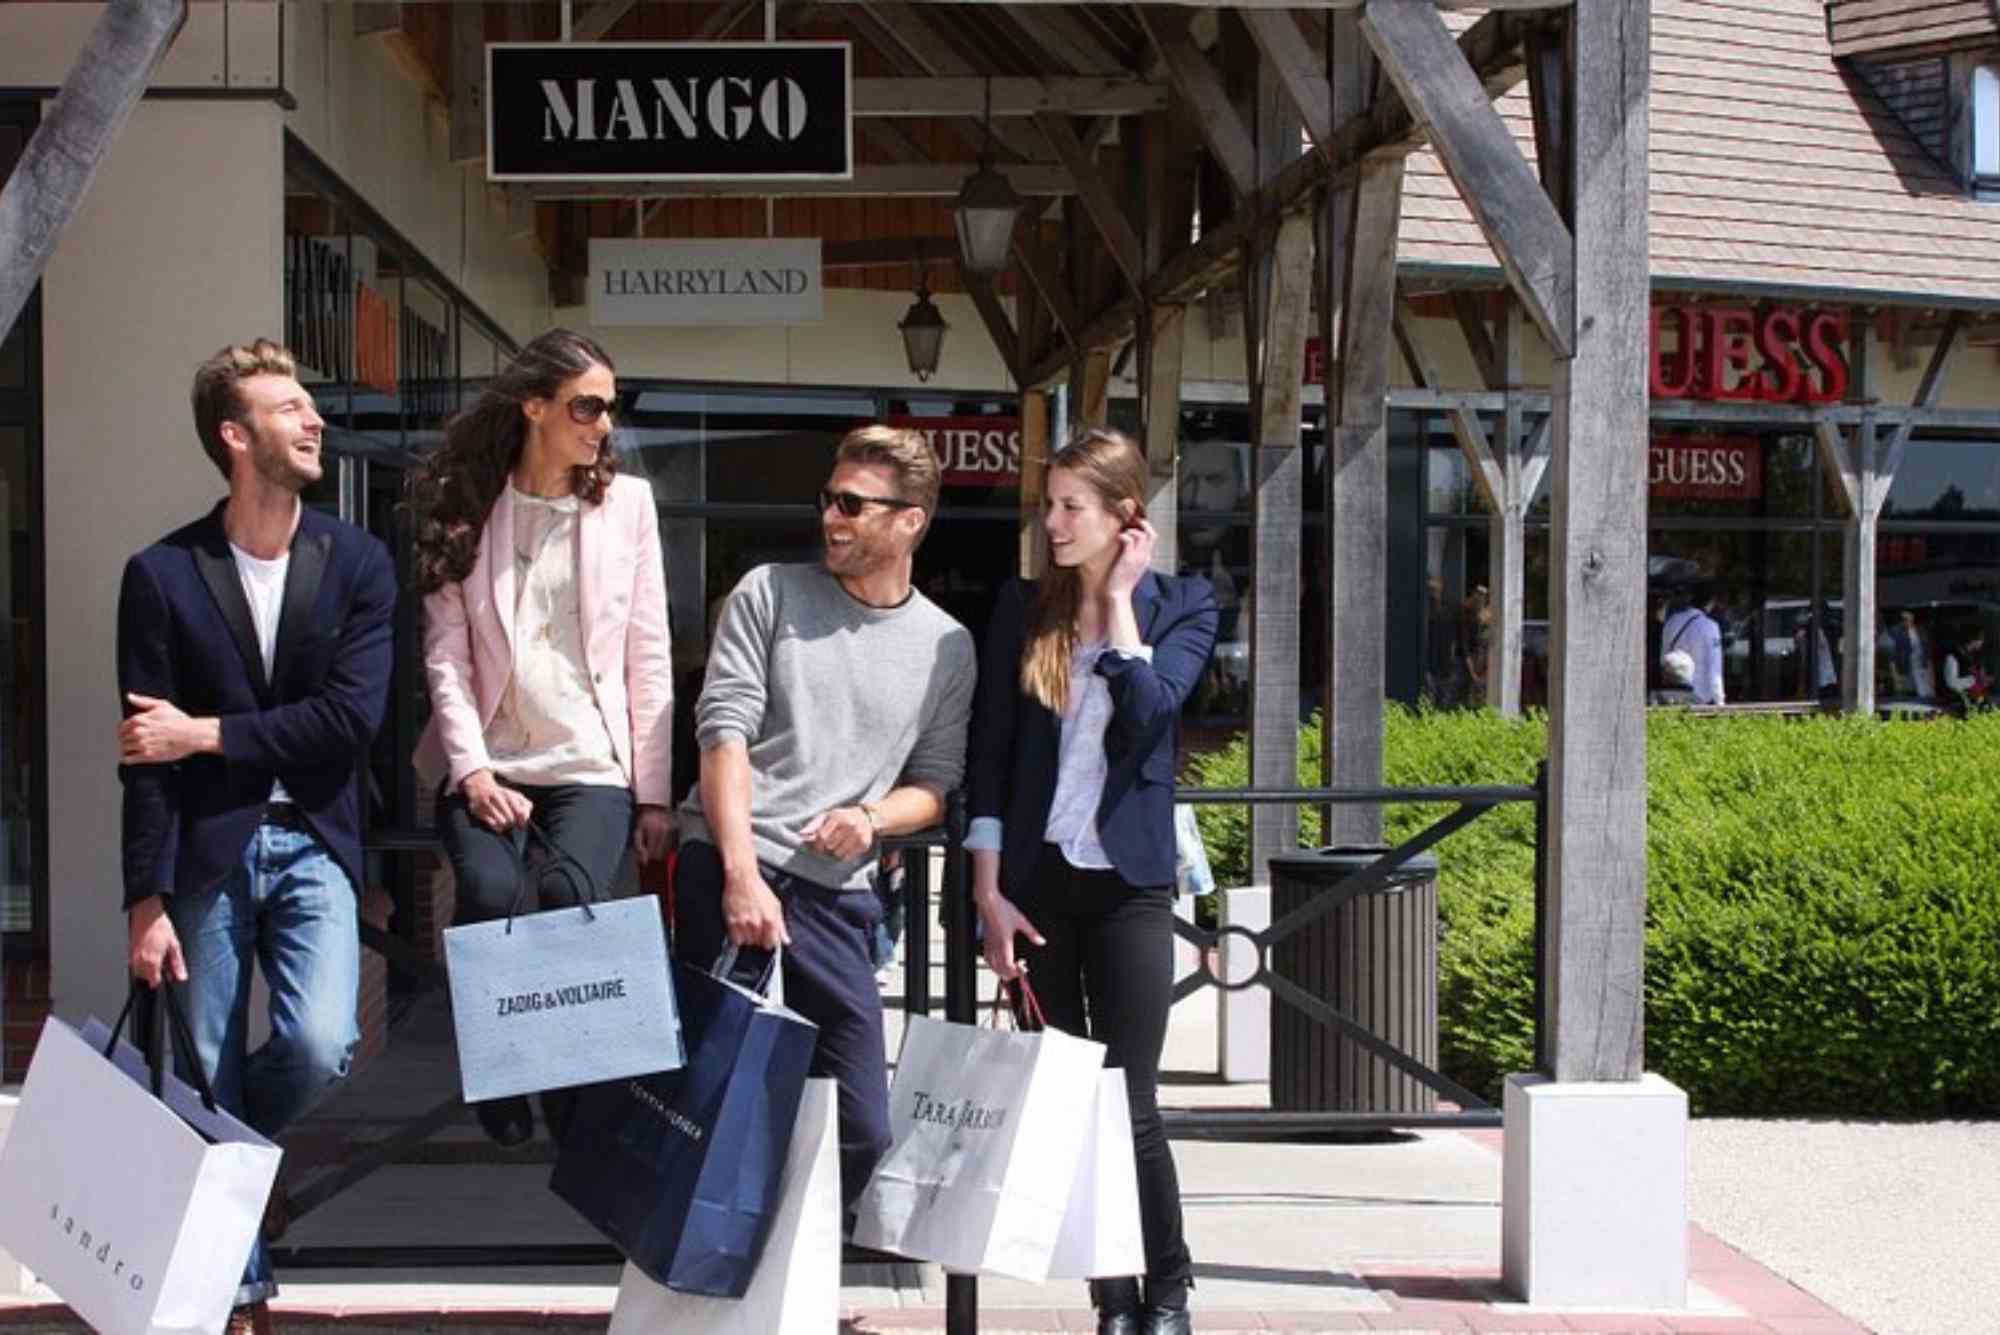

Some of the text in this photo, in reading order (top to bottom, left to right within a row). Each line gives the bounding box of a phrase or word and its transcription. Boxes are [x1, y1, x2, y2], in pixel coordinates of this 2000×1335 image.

[540, 77, 809, 141] MANGO
[604, 268, 810, 295] HARRYLAND
[1649, 303, 1851, 406] UESS
[925, 429, 1020, 473] UESS
[1647, 448, 1745, 486] GUESS
[49, 1203, 145, 1292] sandro
